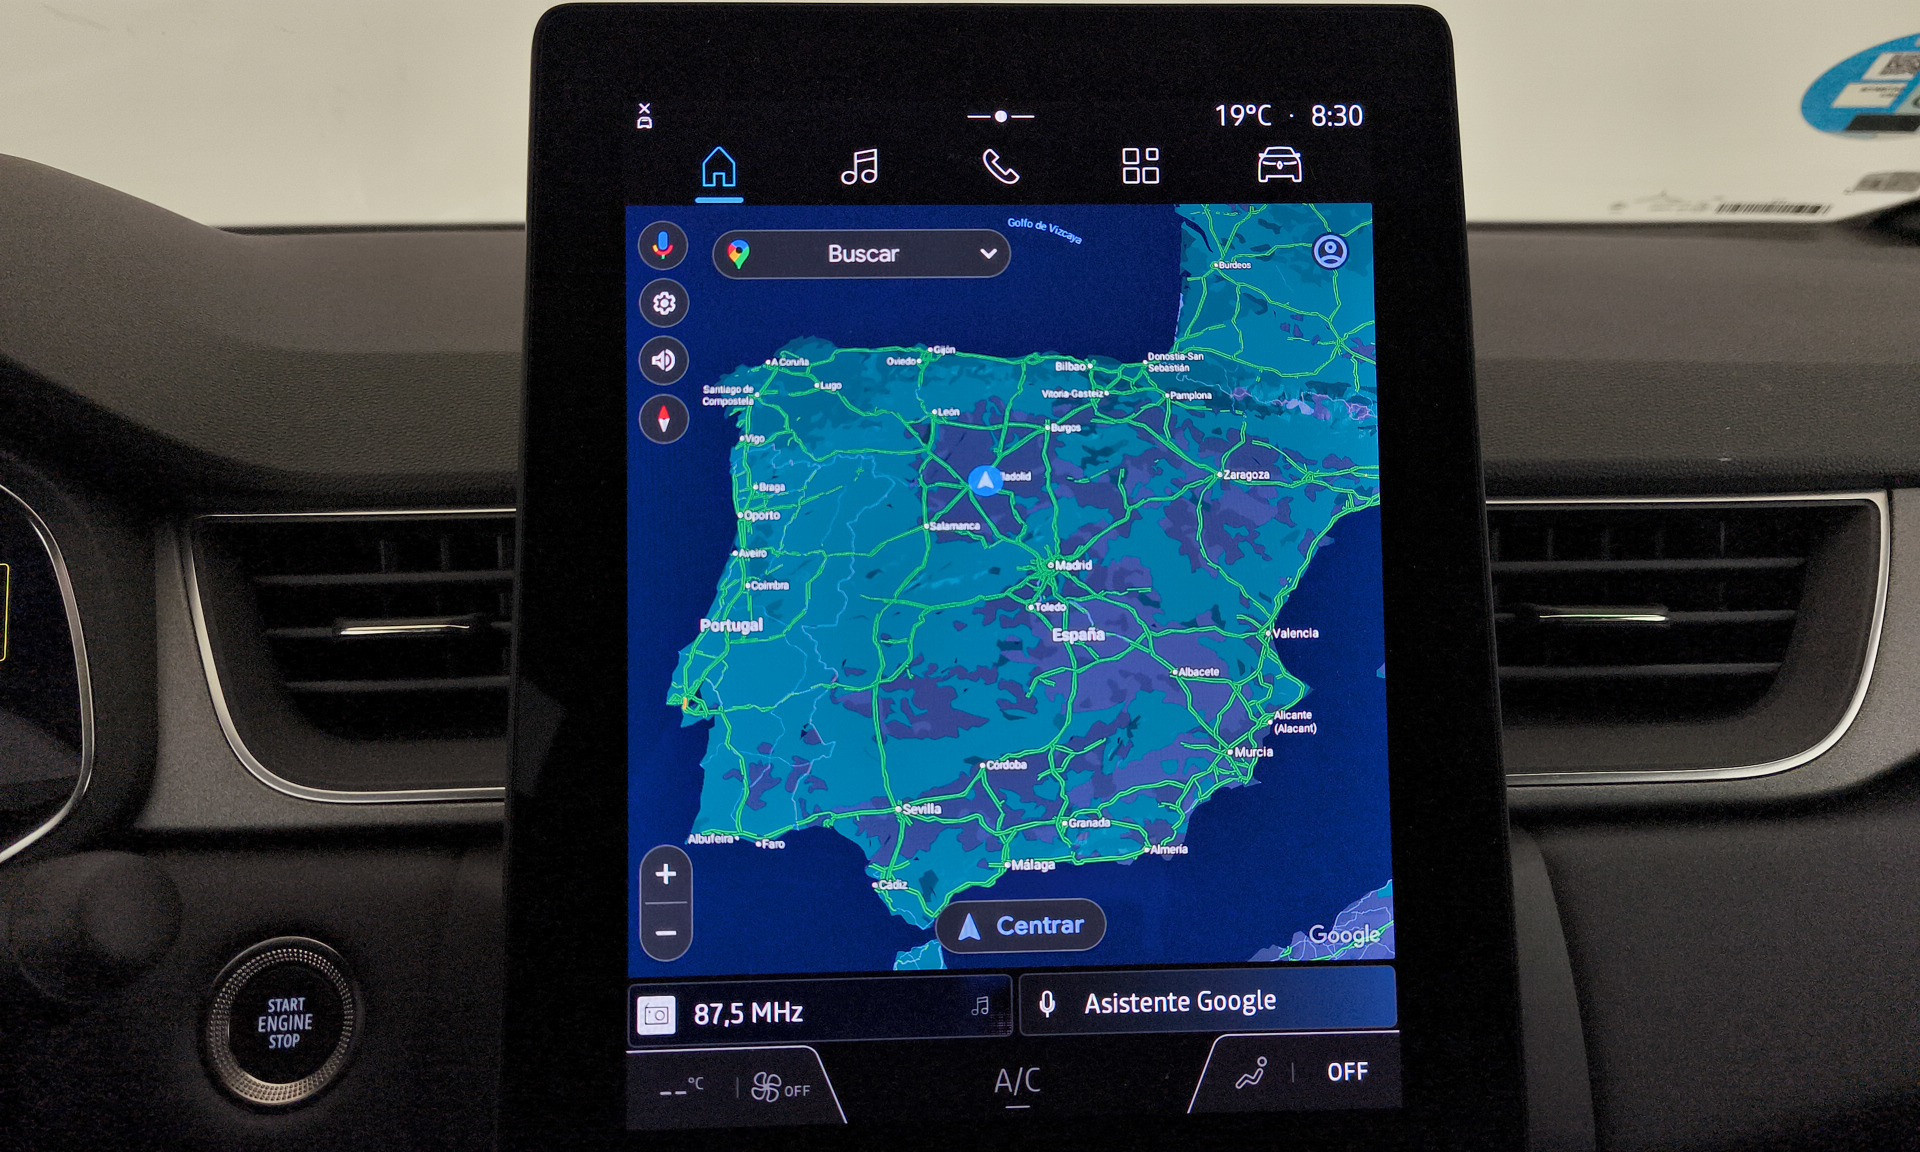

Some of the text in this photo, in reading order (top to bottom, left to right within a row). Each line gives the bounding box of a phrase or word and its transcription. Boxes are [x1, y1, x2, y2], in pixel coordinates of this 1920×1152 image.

[1311, 104, 1363, 127] 8:30
[1007, 217, 1083, 245] Golfo de Vizcaya
[828, 244, 900, 264] Buscar
[1219, 260, 1252, 270] Burdeos
[933, 344, 956, 356] Gijón
[771, 356, 810, 368] A Coruña
[886, 357, 916, 367] Oviedo
[1147, 352, 1204, 362] Donostia-San
[1055, 361, 1087, 372] Bilbao
[1148, 362, 1190, 373] Sebastián
[703, 384, 754, 397] Santiago de
[821, 380, 843, 392] Lugo
[1042, 388, 1104, 399] Vitoria-Gasteiz
[1170, 390, 1212, 402] Pamplona
[702, 396, 754, 408] Compostela
[937, 406, 960, 417] León
[1051, 422, 1082, 435] Burgos
[746, 433, 766, 446] Vigo
[1223, 468, 1270, 483] Zaragoza
[759, 481, 786, 493] Braga
[743, 510, 781, 523] Oporto
[929, 520, 981, 532] Salamanca
[739, 548, 768, 559] Aveiro
[1055, 559, 1093, 572] Madrid
[750, 580, 790, 592] Coimbra
[1035, 601, 1067, 613] Toledo
[700, 616, 764, 634] Portugal
[1052, 626, 1106, 645] España
[1273, 627, 1320, 640] Valencia
[1178, 666, 1220, 678] Albacete
[1274, 710, 1313, 721] Alicante
[1274, 722, 1318, 735] (Alacant)
[1234, 745, 1274, 759] Murcia
[986, 758, 1028, 772] Córdoba
[902, 803, 942, 817] Sevilla
[1068, 816, 1111, 831] Granada
[687, 833, 734, 845] Albufeira
[762, 838, 786, 850] Faro
[1150, 842, 1189, 855] Almería
[1011, 857, 1056, 873] Málaga
[878, 878, 908, 891] Cádiz
[996, 914, 1085, 937] Centrar
[1308, 923, 1381, 949] Google
[268, 997, 306, 1012] START
[1084, 988, 1277, 1017] Asistente Google
[693, 1000, 804, 1028] 87,5 MHz
[258, 1014, 313, 1032] ENGINE
[269, 1034, 300, 1049] STOP
[1327, 1061, 1369, 1082] OFF
[994, 1067, 1041, 1097] A/C
[784, 1084, 811, 1098] OFF
